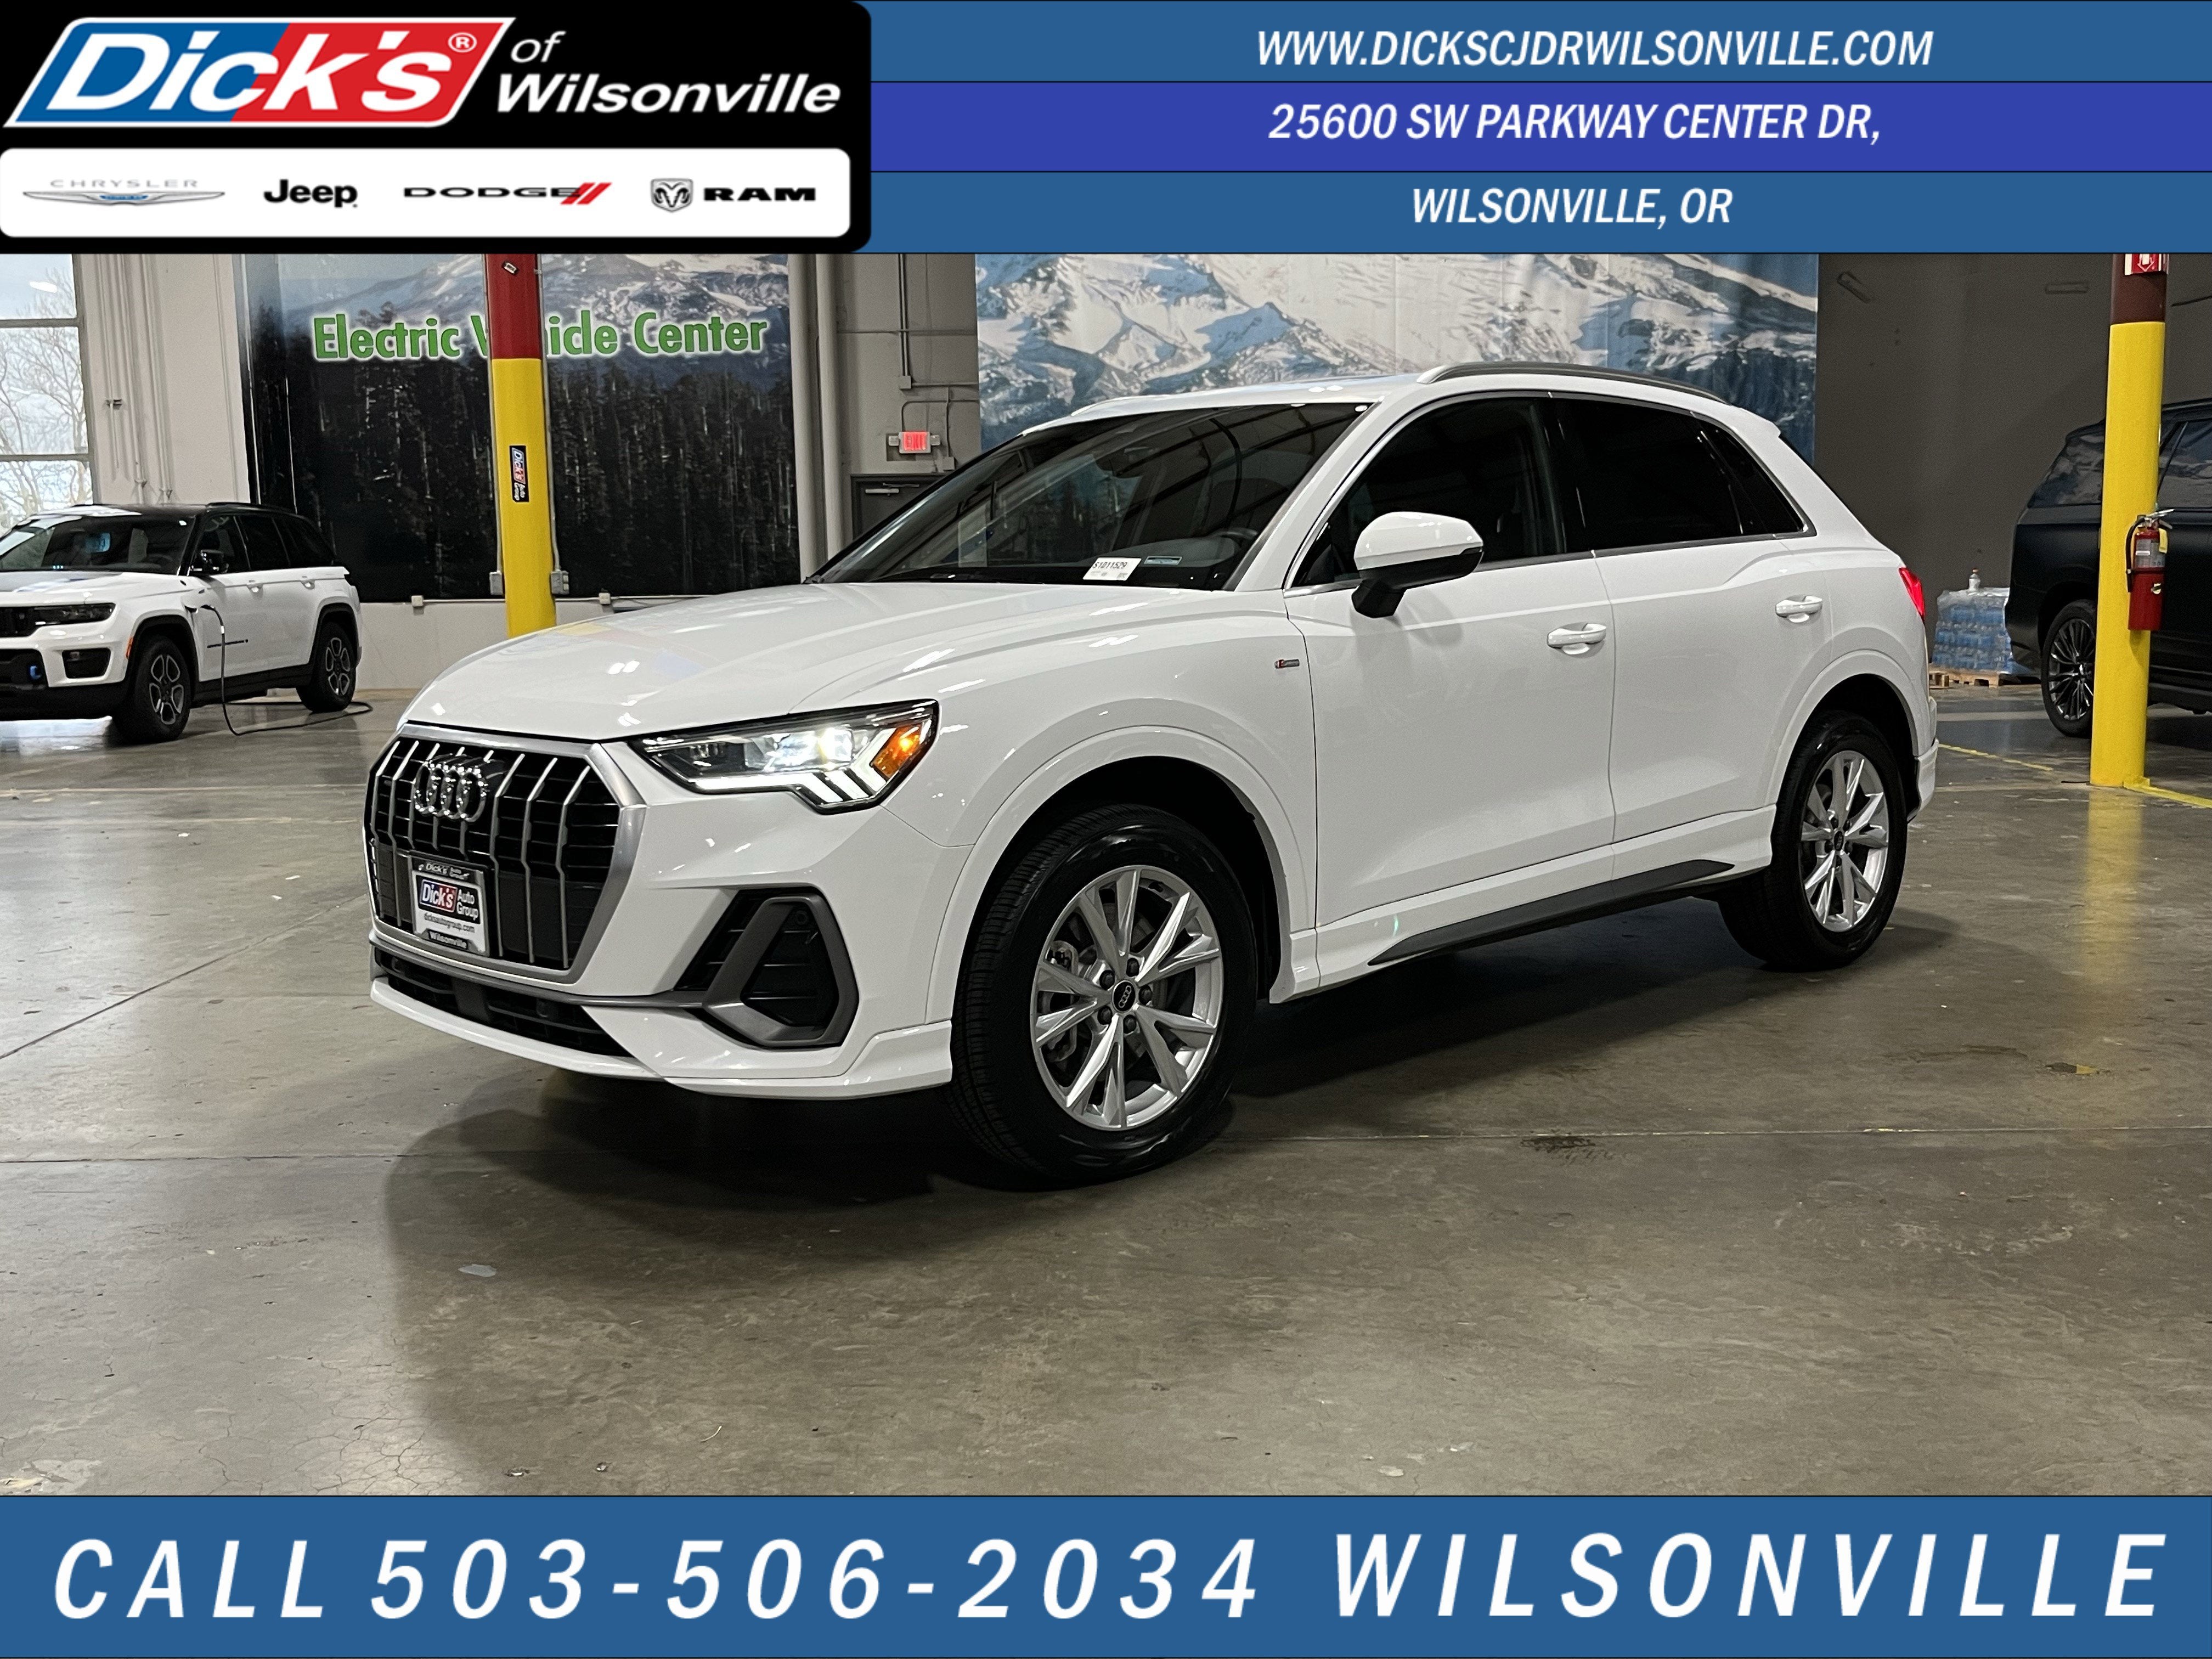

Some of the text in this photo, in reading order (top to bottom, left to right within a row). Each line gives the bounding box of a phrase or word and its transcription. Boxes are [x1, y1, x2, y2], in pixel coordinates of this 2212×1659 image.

[313, 313, 461, 359] Electric
[633, 312, 768, 354] Center
[458, 889, 475, 905] Auto
[456, 901, 479, 921] Group
